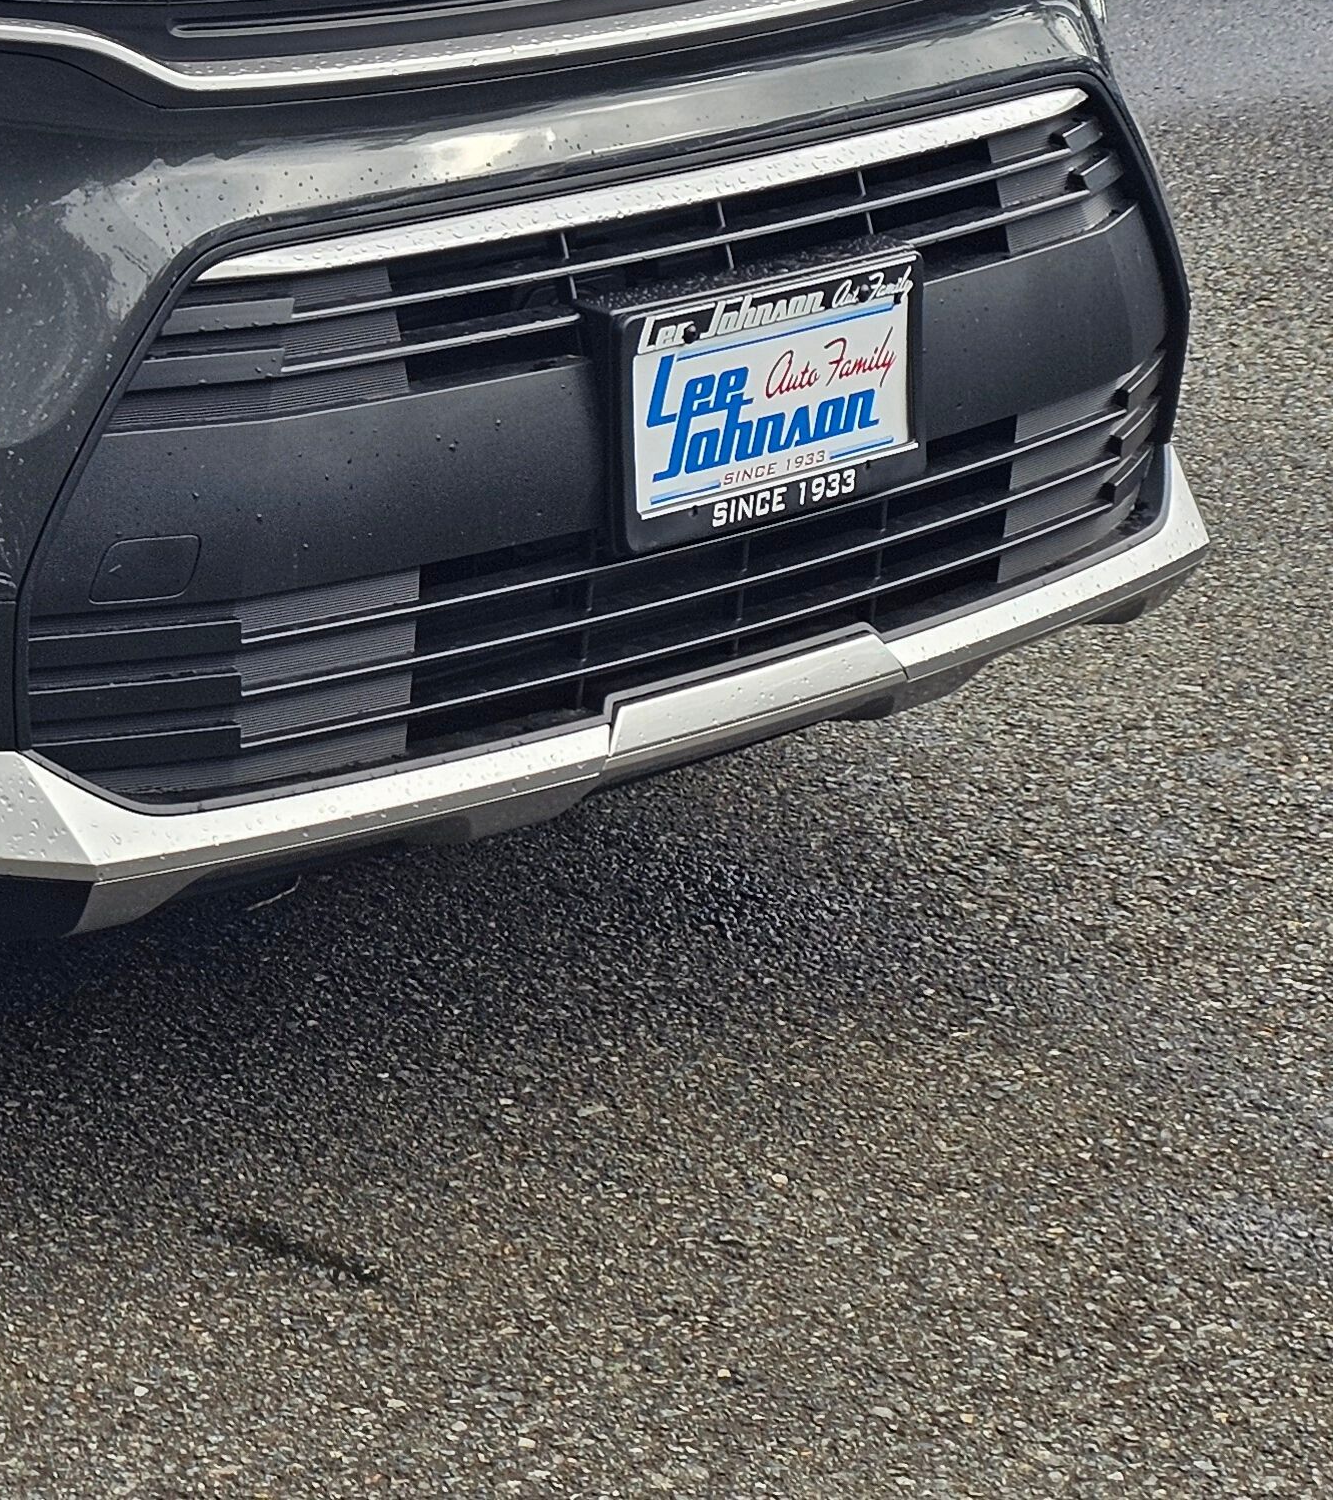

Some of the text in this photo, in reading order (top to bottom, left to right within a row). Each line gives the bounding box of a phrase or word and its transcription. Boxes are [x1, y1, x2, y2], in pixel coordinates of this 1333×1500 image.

[699, 290, 826, 340] Johnson
[646, 354, 753, 427] Lee
[765, 326, 897, 399] Auto Family
[652, 389, 880, 483] Johnson
[723, 451, 827, 486] SINCE 1933
[712, 468, 856, 528] SINCE 1933
